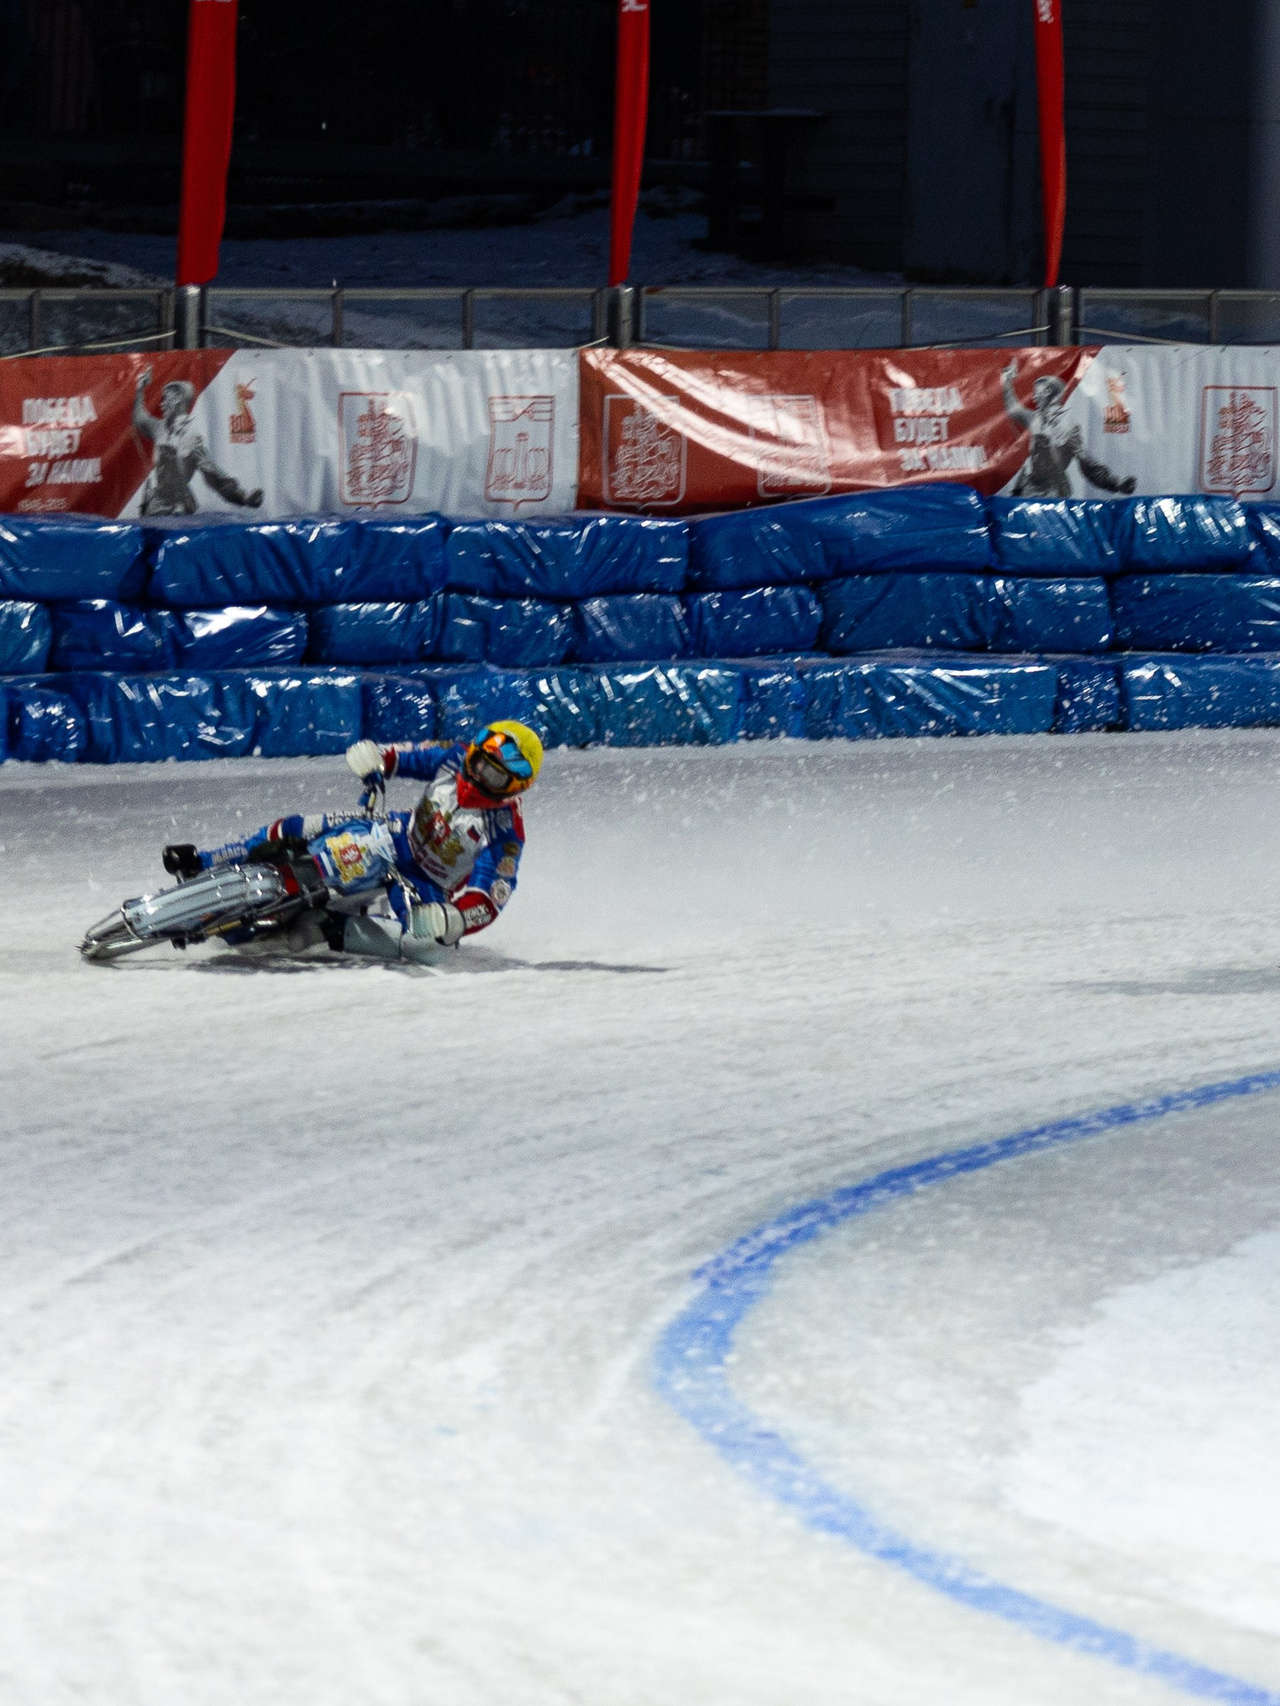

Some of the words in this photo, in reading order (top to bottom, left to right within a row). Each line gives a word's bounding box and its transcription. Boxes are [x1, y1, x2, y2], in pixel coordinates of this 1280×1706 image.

[22, 395, 97, 426] ПОБЕДА
[888, 387, 963, 414] ПОБЕДА
[24, 428, 82, 458] БУДЕТ
[894, 416, 950, 444] БУДЕТ
